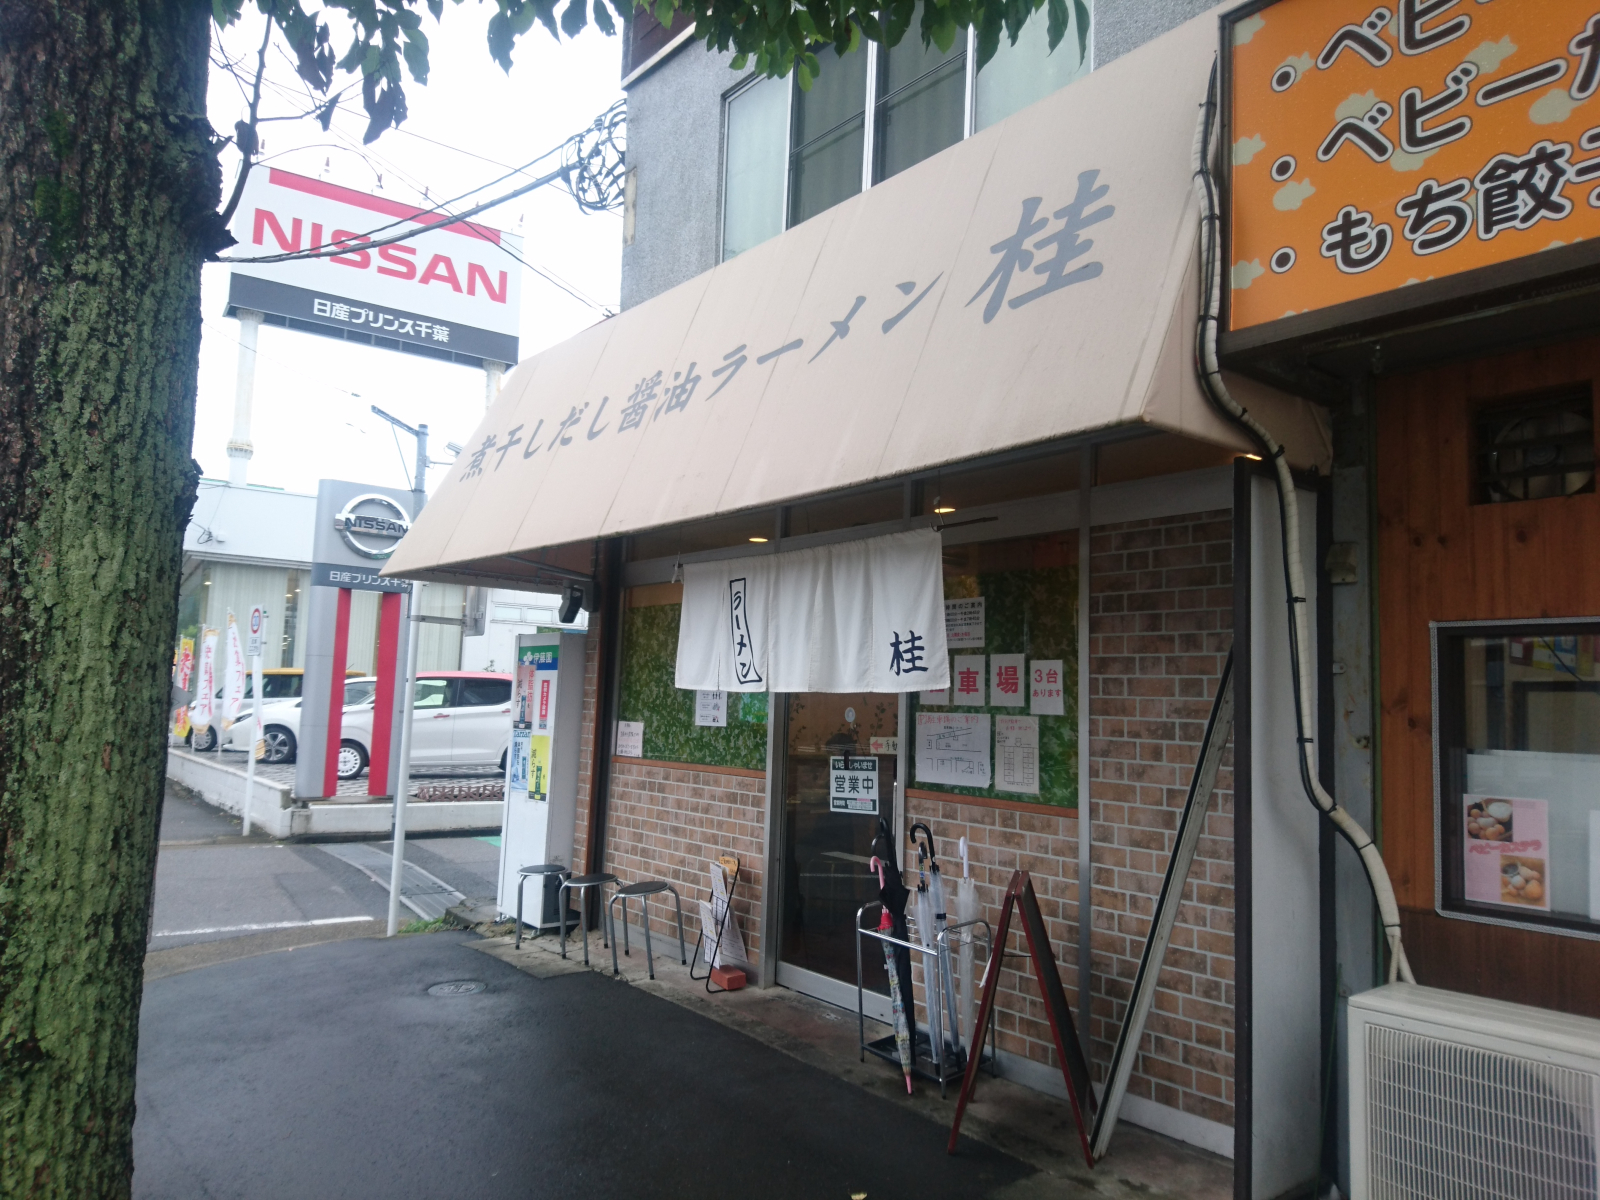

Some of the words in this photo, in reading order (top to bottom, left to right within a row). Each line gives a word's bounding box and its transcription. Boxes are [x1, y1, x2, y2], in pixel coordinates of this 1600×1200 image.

[1316, 0, 1492, 70] ベビ
[1320, 124, 1600, 274] もち餃
[252, 207, 508, 304] NISSAN
[313, 298, 450, 343] 日産プリンス千葉
[459, 271, 944, 482] 煮干しだし醤油ラーメン
[964, 169, 1115, 324] 桂
[345, 518, 409, 533] NISSAN
[733, 590, 751, 679] ラーメン
[889, 630, 928, 676] 桂
[1032, 688, 1062, 698] あります
[1034, 668, 1059, 684] 3台
[835, 761, 873, 769] いらしゃいませ
[835, 774, 874, 794] 営業中
